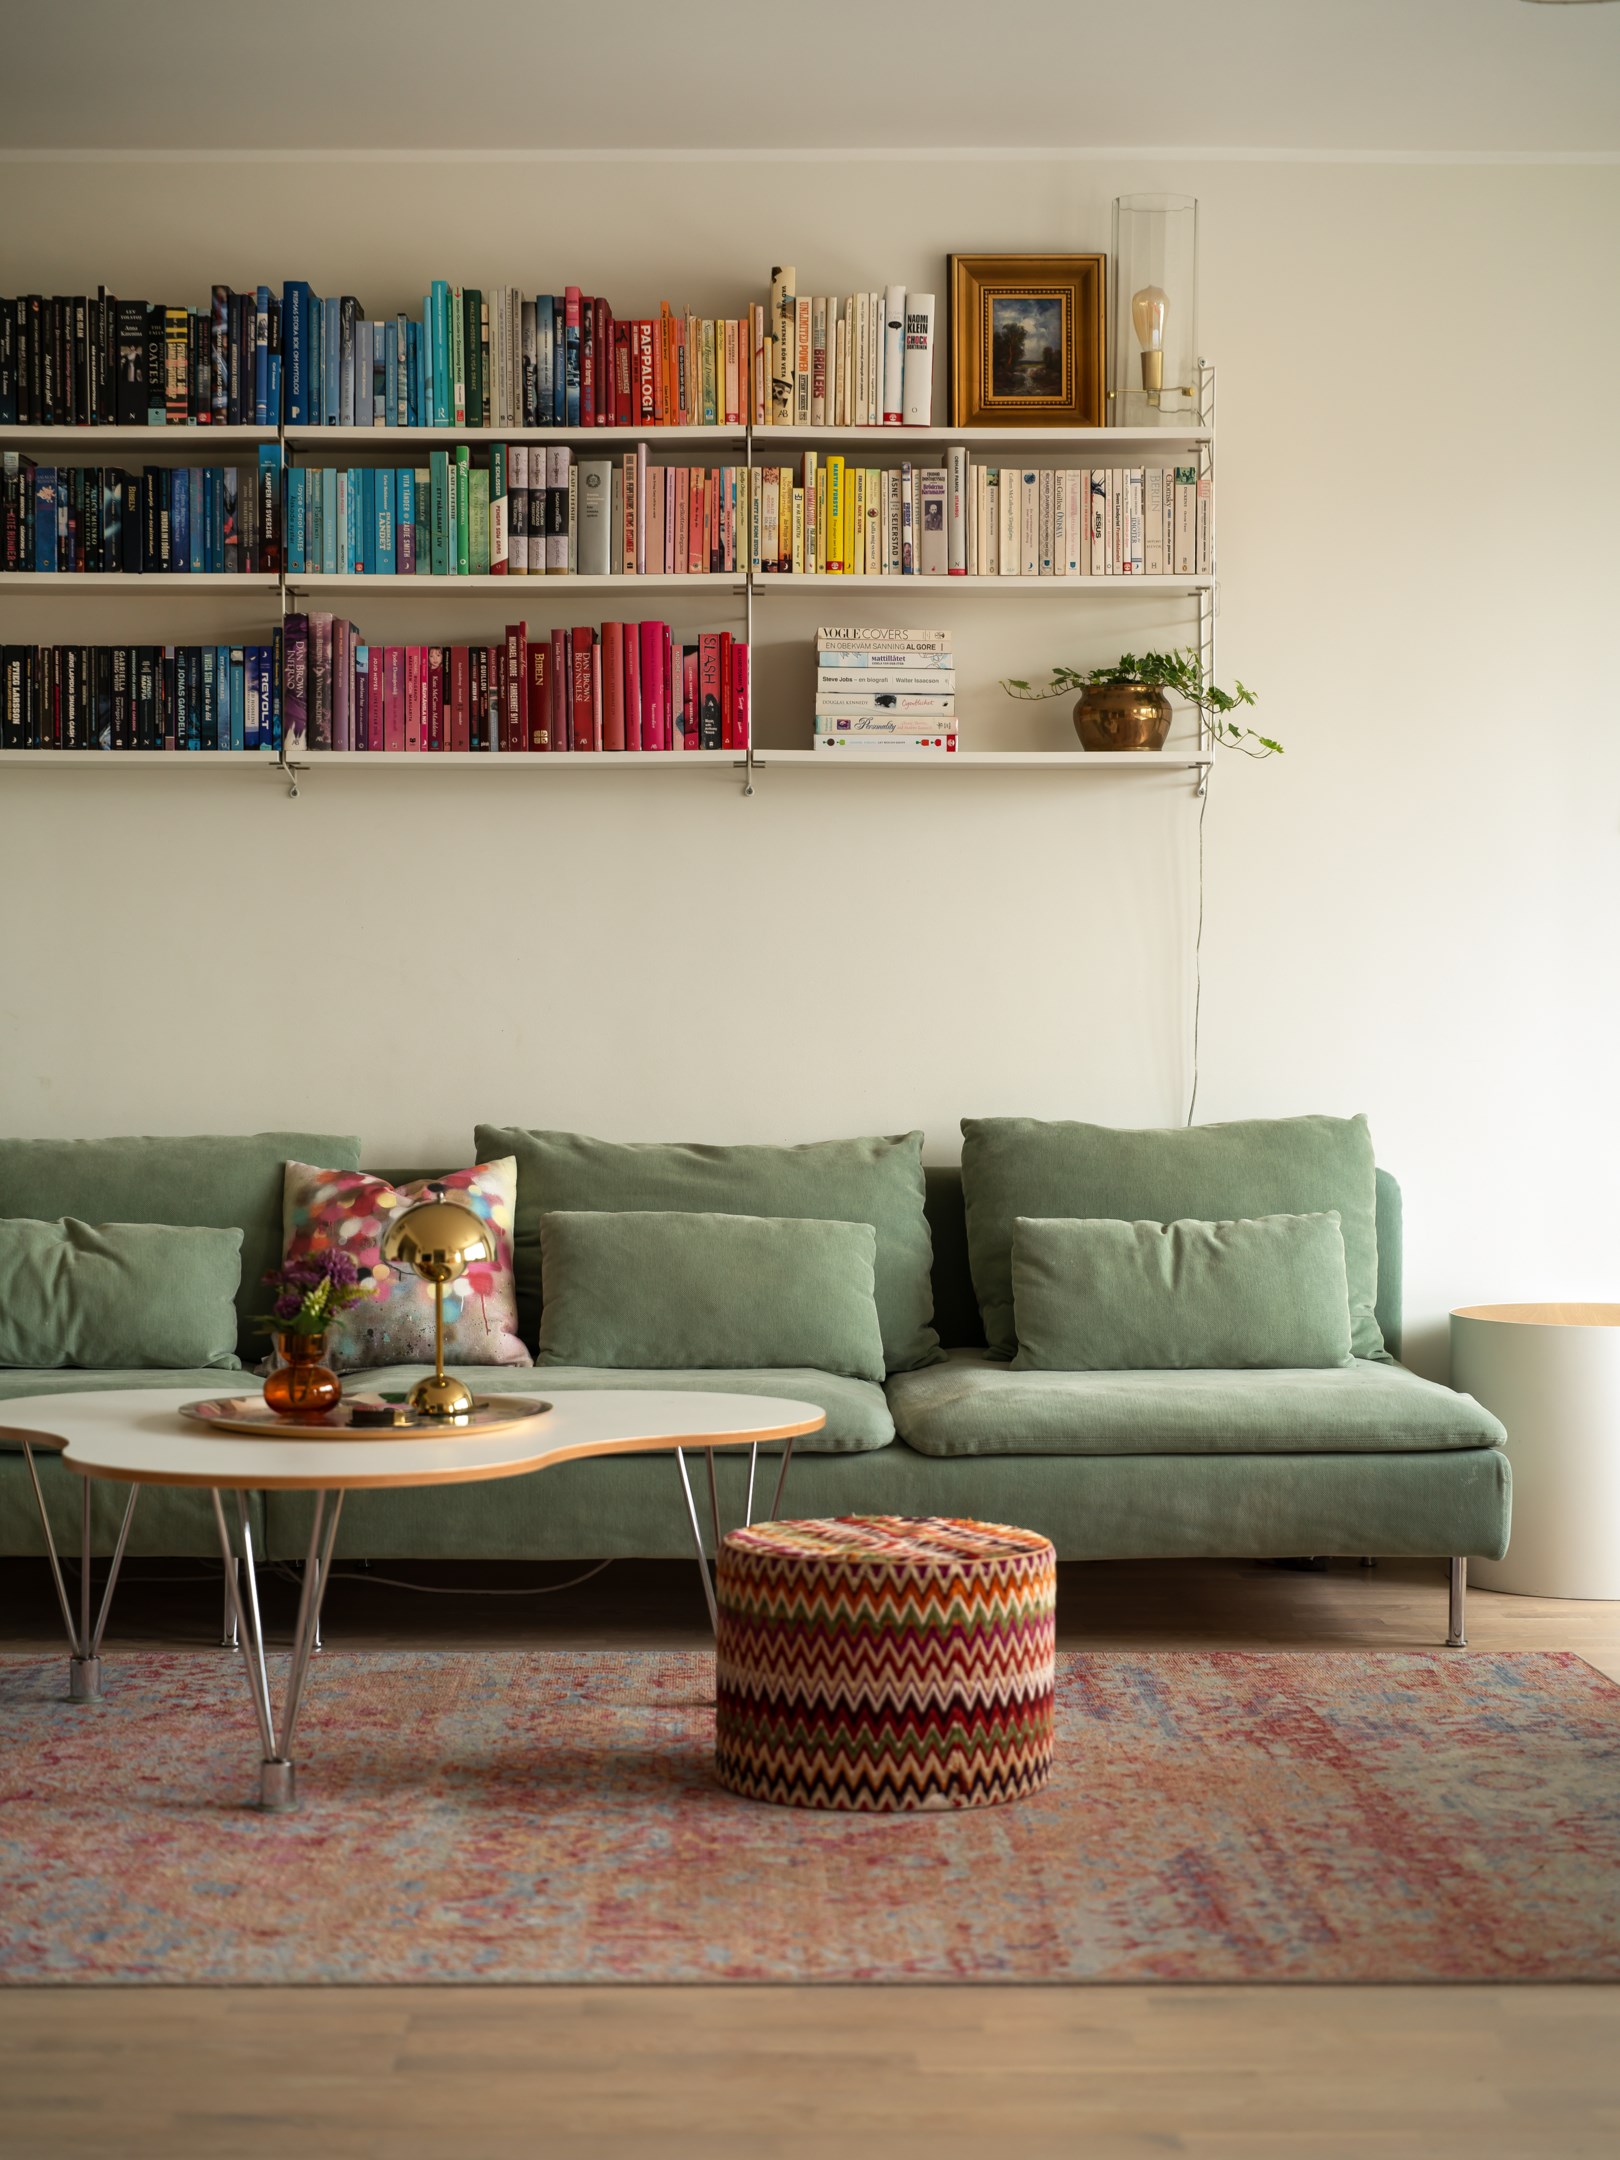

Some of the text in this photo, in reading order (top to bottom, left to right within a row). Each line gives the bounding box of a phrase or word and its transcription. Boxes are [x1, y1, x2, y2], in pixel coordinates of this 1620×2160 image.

[799, 301, 809, 372] UNLIMITED POWER
[907, 315, 928, 323] NAOMI
[907, 323, 928, 334] KLEIN
[292, 351, 299, 362] OM
[906, 335, 928, 345] CHOCK
[148, 343, 158, 384] OATES
[641, 325, 653, 412] PAPPALOGI
[813, 349, 825, 398] BROILERS
[265, 499, 272, 509] OM
[1056, 475, 1064, 511] Jan Guillou
[1150, 475, 1161, 512] BERLIN
[1164, 474, 1173, 508] Chomsky
[6, 513, 16, 561] KITE RUNNER
[378, 512, 386, 551] LANDET
[891, 513, 899, 556] SEIERSTAD
[823, 628, 909, 640] VOGUE COVERS
[837, 642, 872, 650] OBEKVÄM
[204, 654, 213, 671] VIVECA
[204, 672, 213, 683] STEN
[285, 650, 295, 690] INFERNO
[296, 641, 305, 698] DAN BROWN
[508, 636, 519, 724] MICHAEL MOORE FAHRENHEIT 9/11
[535, 653, 545, 686] BIBELN
[575, 652, 583, 703] BEGYNNELSE
[583, 652, 591, 702] DAN BROWN
[703, 637, 716, 684] SLASH
[12, 661, 20, 725] STIEG LARSSON
[261, 672, 269, 730] REVOLT
[854, 717, 897, 733] Personality
